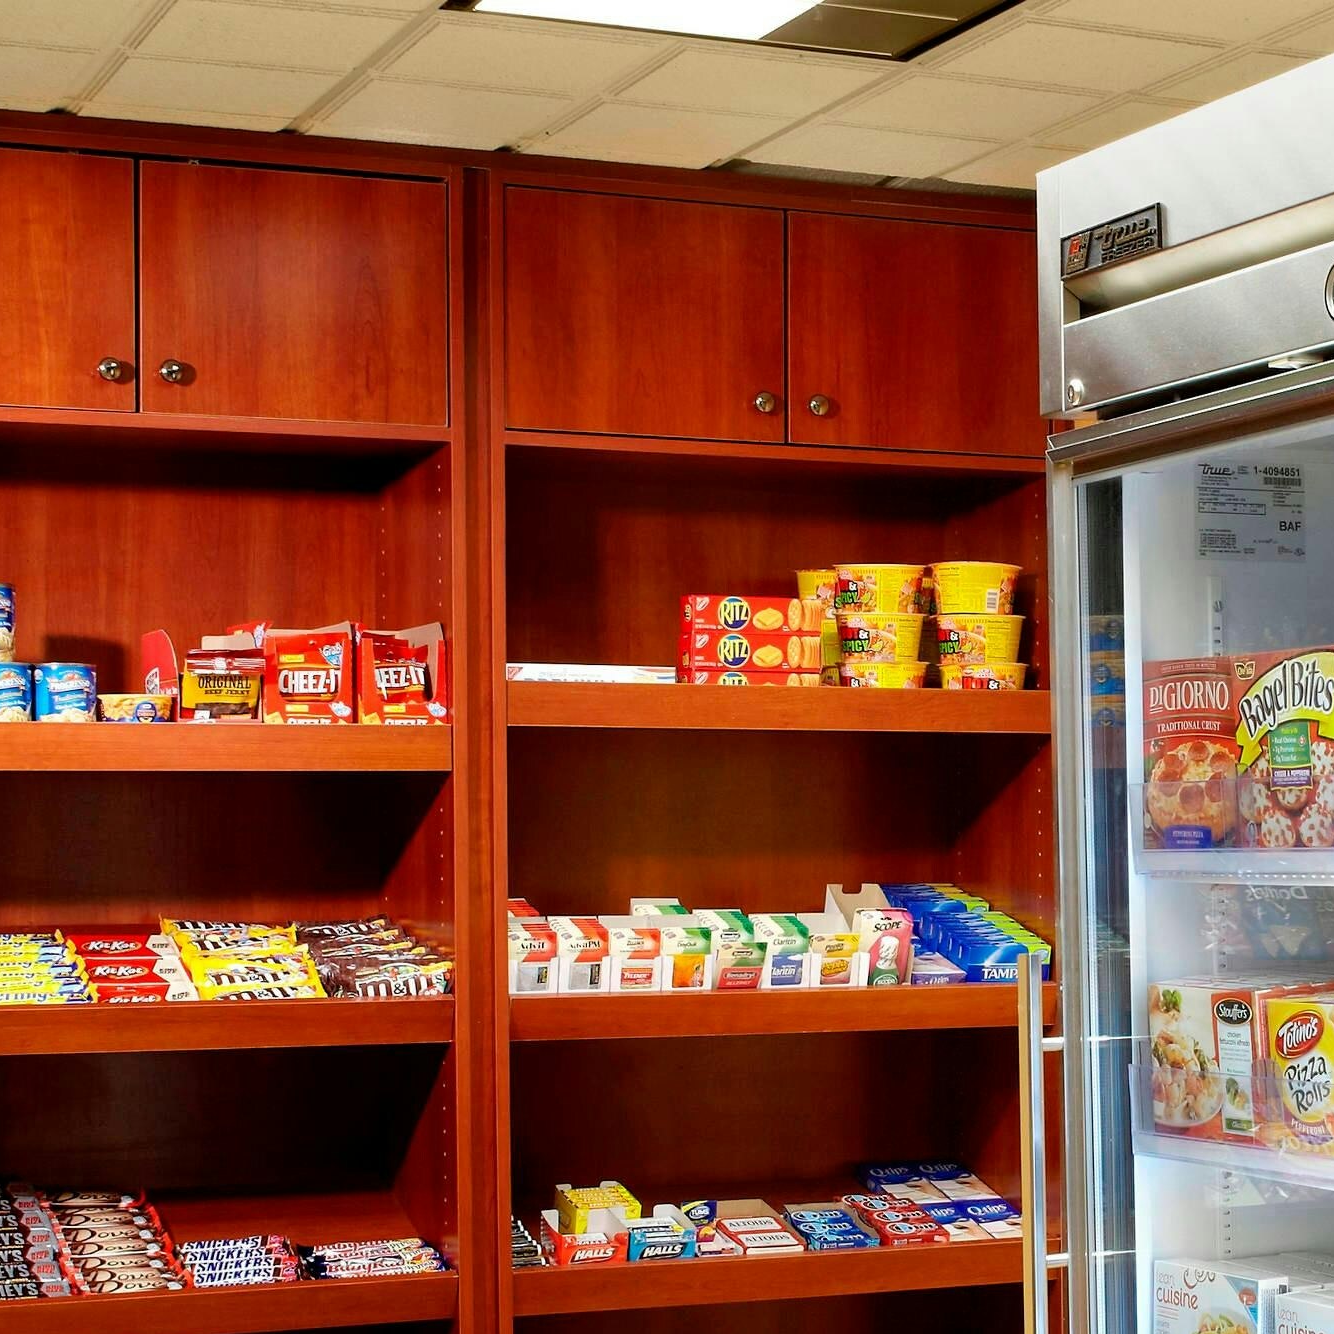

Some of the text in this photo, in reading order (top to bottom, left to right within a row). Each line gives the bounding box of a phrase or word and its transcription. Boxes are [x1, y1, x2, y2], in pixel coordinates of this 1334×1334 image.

[1100, 236, 1154, 264] FREEZER
[1253, 466, 1301, 478] 1-4094851
[1279, 521, 1302, 531] BAF
[835, 592, 859, 608] SPICY
[719, 601, 749, 624] RITZ
[718, 639, 749, 662] RITZ
[842, 639, 869, 653] SPICY
[197, 674, 251, 690] ORIGINAL
[1149, 680, 1230, 713] DIGIORNO
[1239, 659, 1334, 739] Bagel Bites
[1157, 720, 1221, 734] TRADITIONAL CRUST
[873, 920, 903, 932] SCOPE
[87, 941, 138, 951] Kit Kat
[773, 937, 797, 946] Claritin
[94, 966, 145, 977] Kit Kat
[982, 967, 1019, 980] TAMP
[1218, 1003, 1249, 1021] Stouffer's
[1278, 1016, 1319, 1053] Totino's
[1284, 1056, 1328, 1090] Pizza
[1291, 1080, 1331, 1114] Rolls
[1291, 1118, 1326, 1135] PEPPERONI
[57, 1213, 129, 1226] Dove
[62, 1227, 136, 1242] Dove
[68, 1242, 144, 1255] Dove
[575, 1247, 616, 1262] HALLS
[643, 1244, 684, 1259] HALLS
[70, 1256, 145, 1270] Dove
[87, 1280, 164, 1294] Dove
[1156, 1287, 1199, 1310] cuisine
